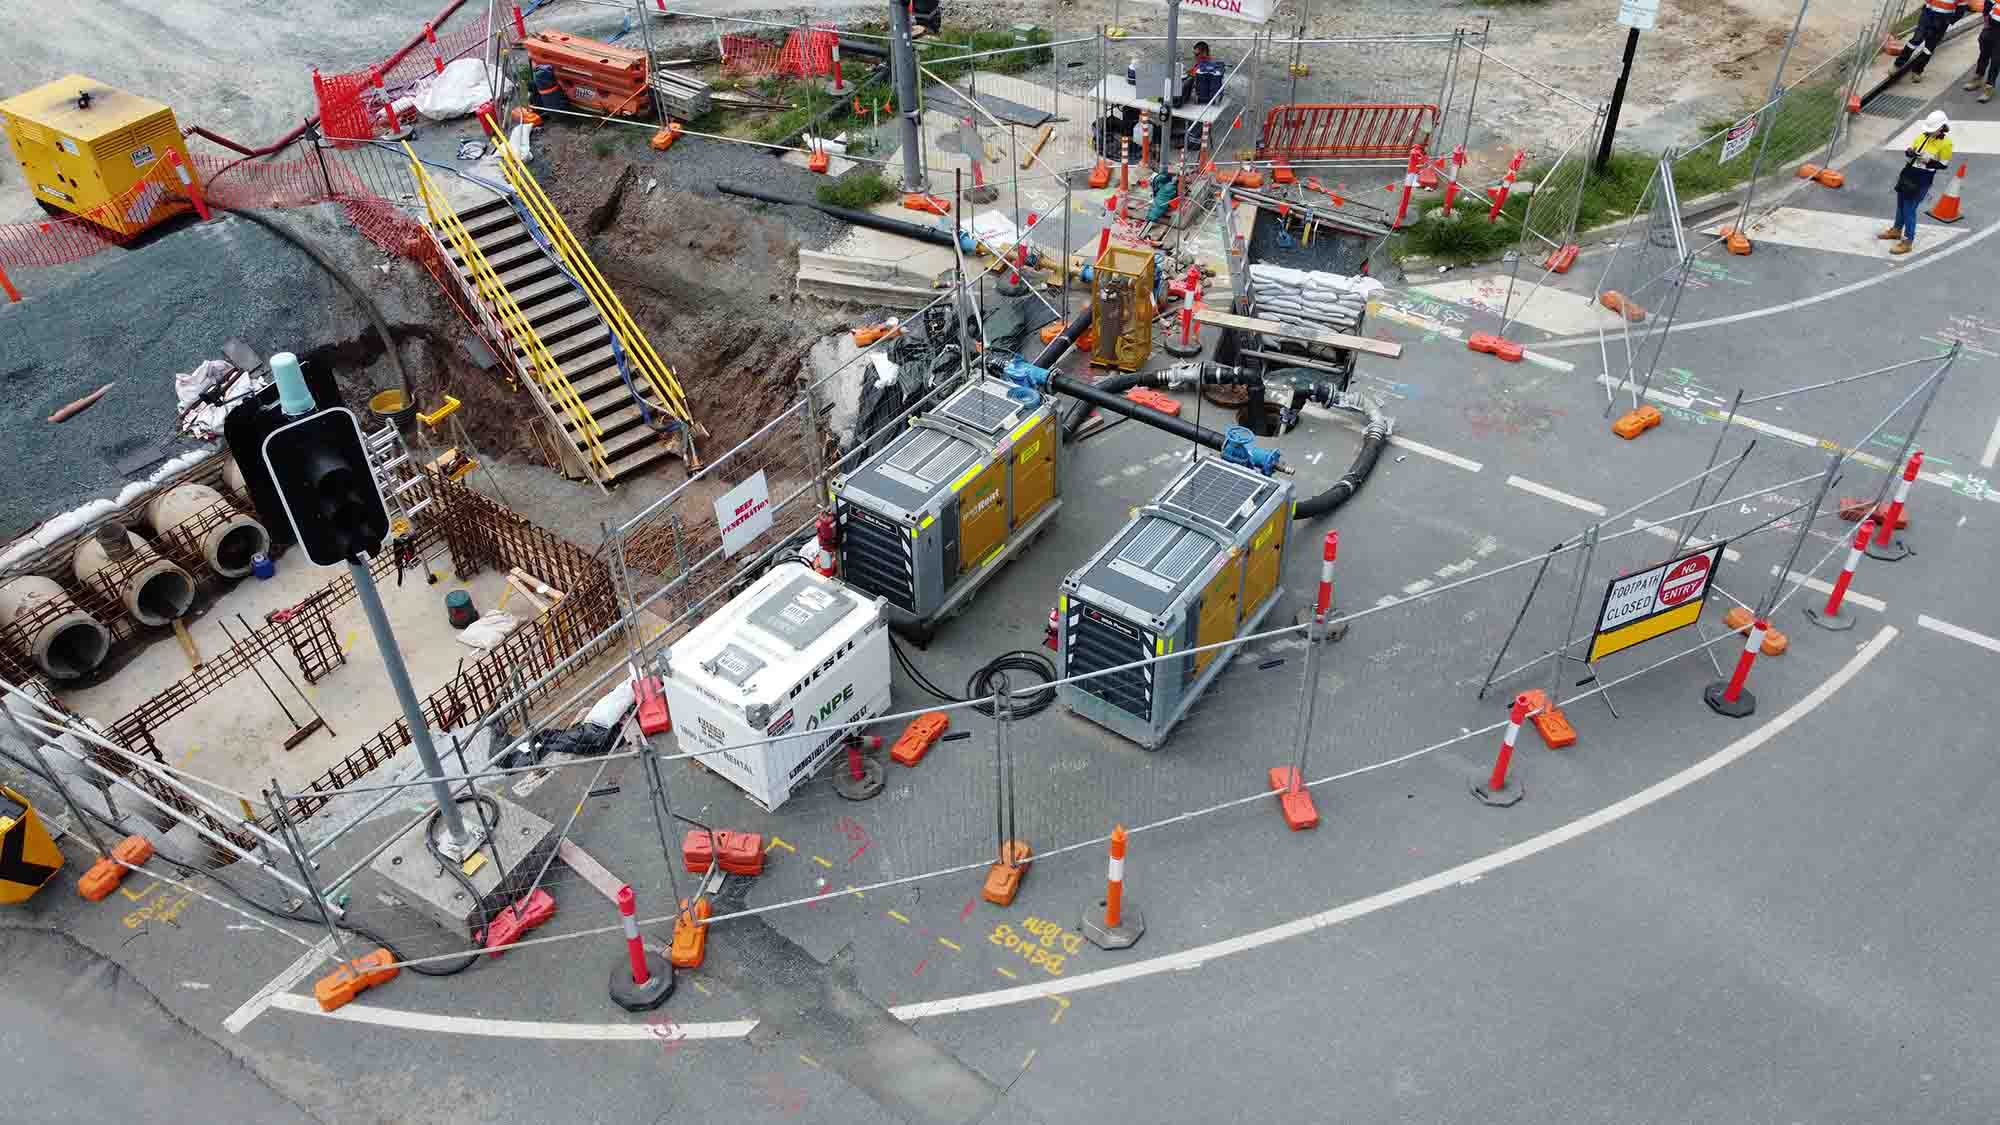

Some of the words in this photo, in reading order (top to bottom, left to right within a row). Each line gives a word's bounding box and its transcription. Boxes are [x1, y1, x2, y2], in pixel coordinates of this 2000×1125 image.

[722, 499, 769, 537] PENETRATION
[735, 498, 753, 516] DEEP
[1681, 562, 1697, 575] NO
[1611, 573, 1660, 601] FOOTPATH
[1664, 580, 1699, 601] ENTRY
[1606, 595, 1651, 621] CLOSED
[789, 640, 855, 699] DIESEL
[819, 683, 854, 721] NPE
